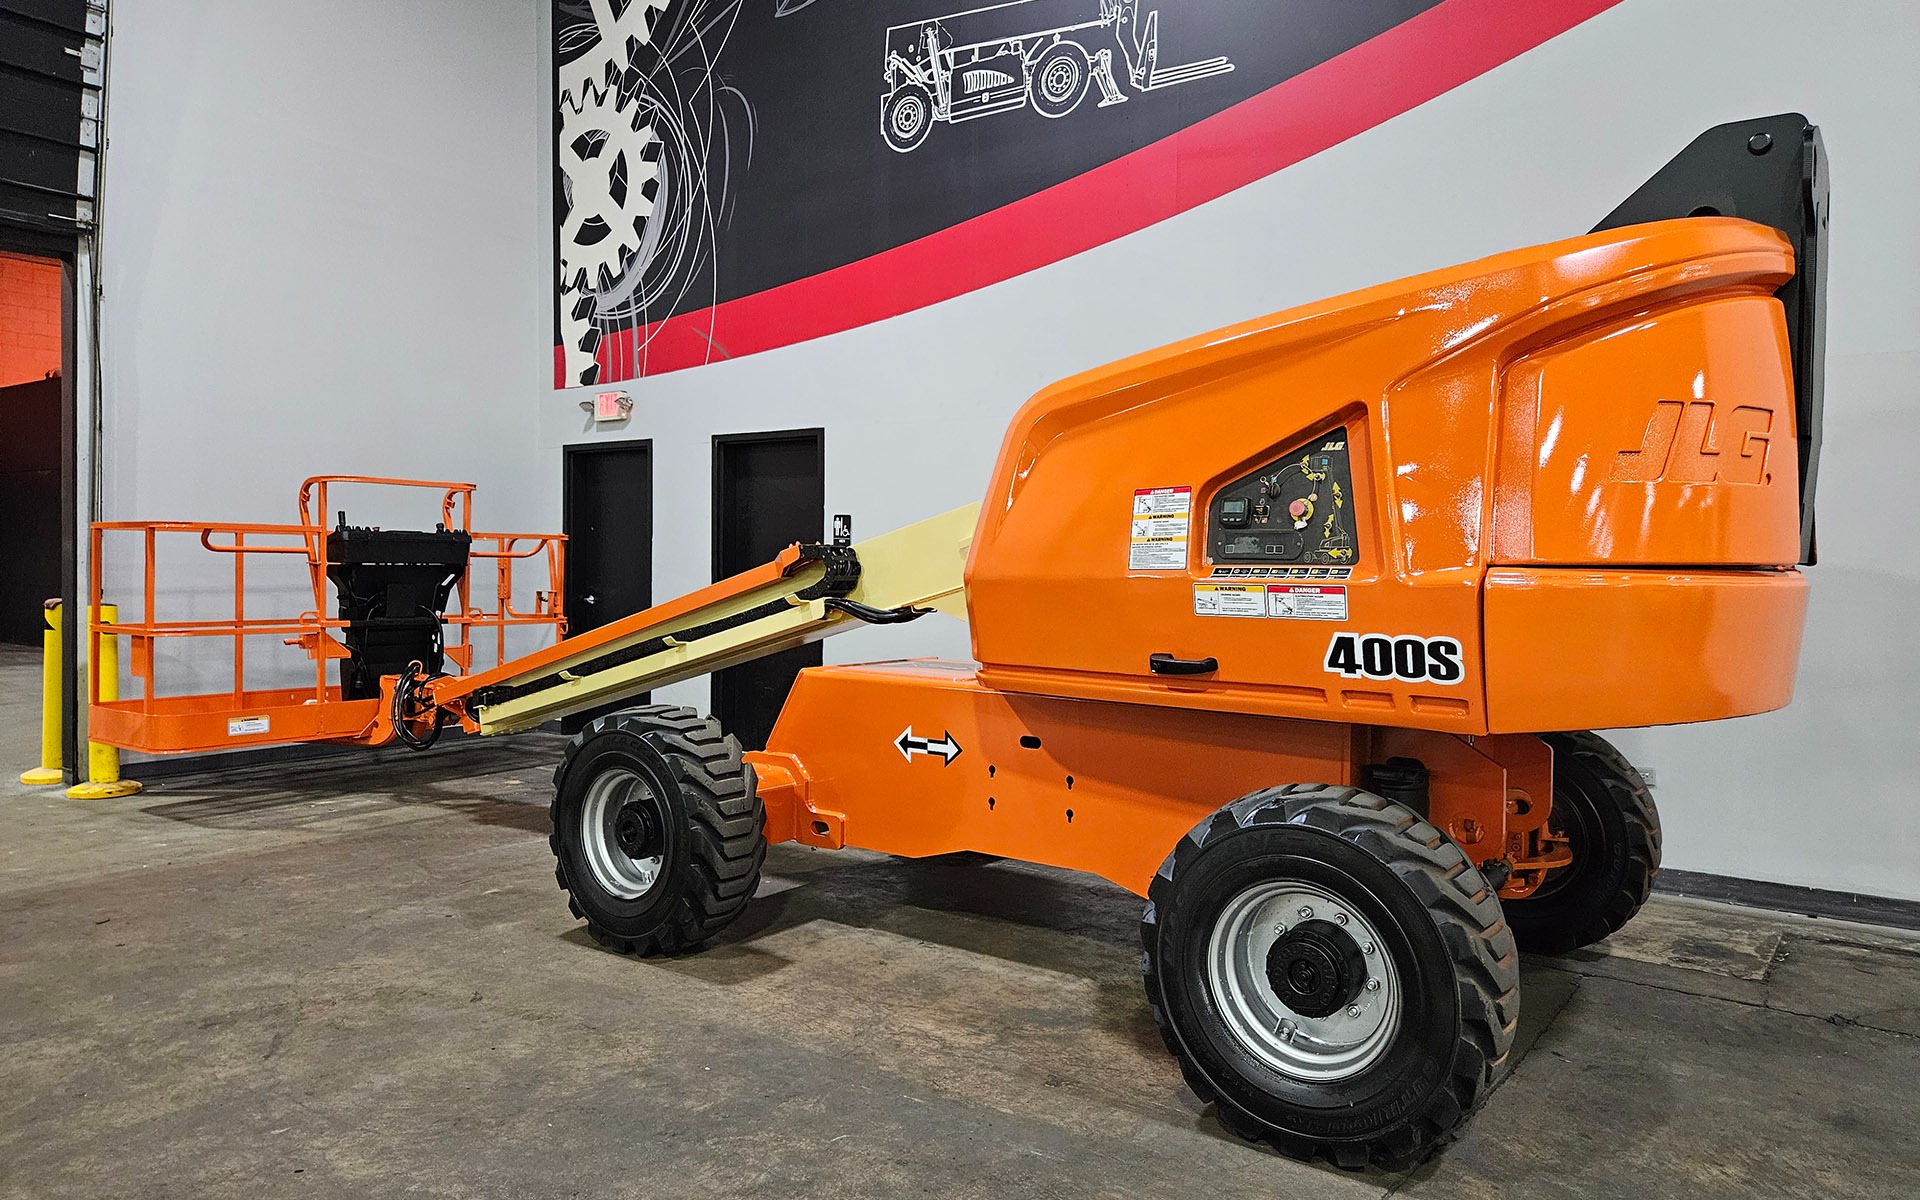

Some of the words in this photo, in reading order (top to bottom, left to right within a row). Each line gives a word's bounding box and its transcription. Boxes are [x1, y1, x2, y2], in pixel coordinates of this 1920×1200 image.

[599, 393, 618, 415] EXIT
[1321, 441, 1345, 451] JLG
[1611, 399, 1774, 487] JLG
[1327, 635, 1460, 681] 400S
